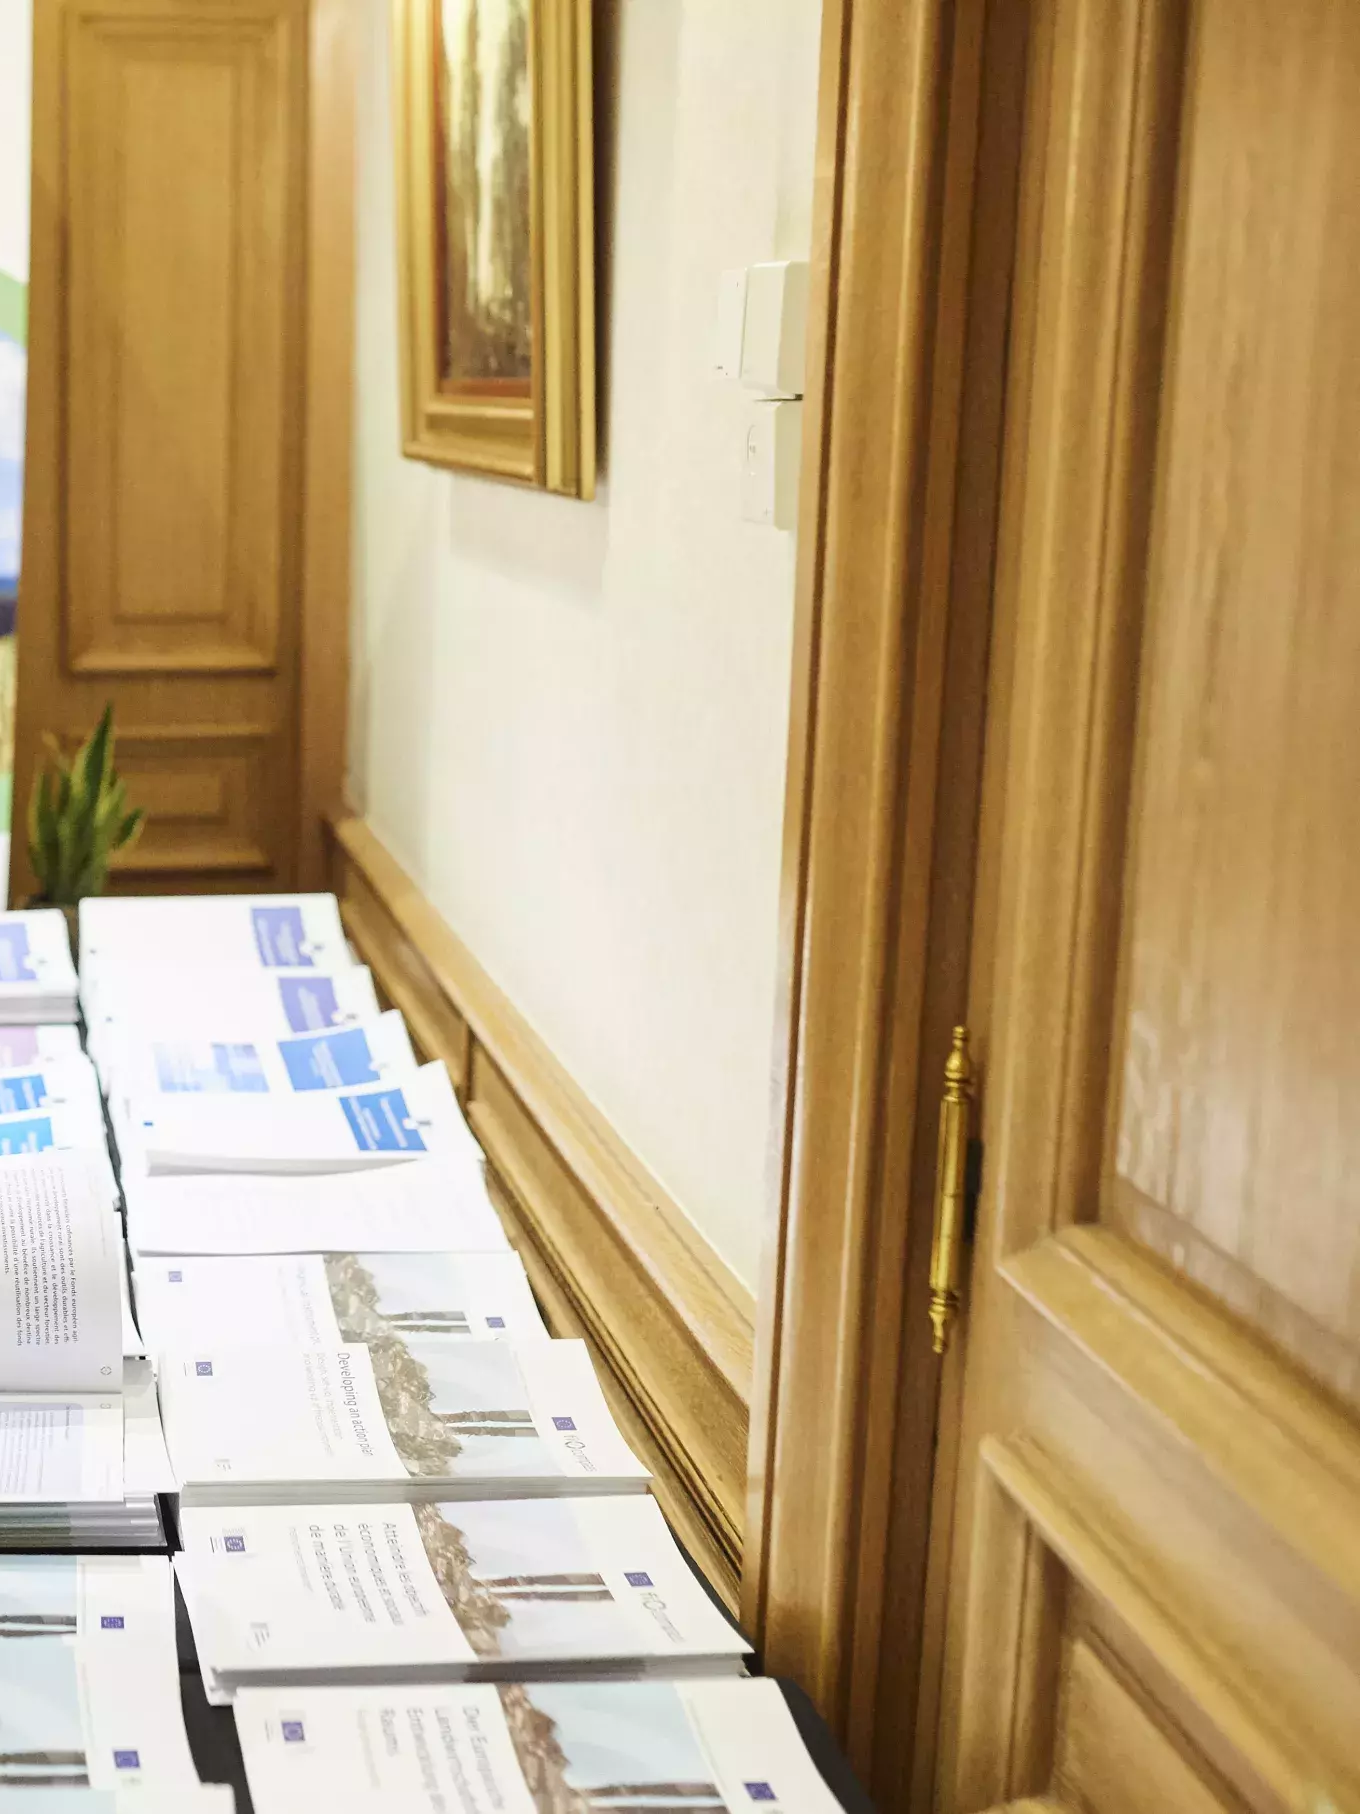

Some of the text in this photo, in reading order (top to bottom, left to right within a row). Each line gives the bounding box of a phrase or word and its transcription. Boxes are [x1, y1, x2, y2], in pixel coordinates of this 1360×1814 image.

[10, 1226, 18, 1256] possibilité
[40, 1239, 48, 1276] l'agriculture
[32, 1256, 40, 1294] soutiennent
[337, 1352, 374, 1456] Developing an action plan
[309, 1525, 325, 1538] de
[334, 1524, 349, 1538] de
[383, 1522, 404, 1569] Atteindre
[312, 1540, 334, 1580] manière
[338, 1540, 358, 1574] l'Union
[358, 1523, 388, 1587] économiques
